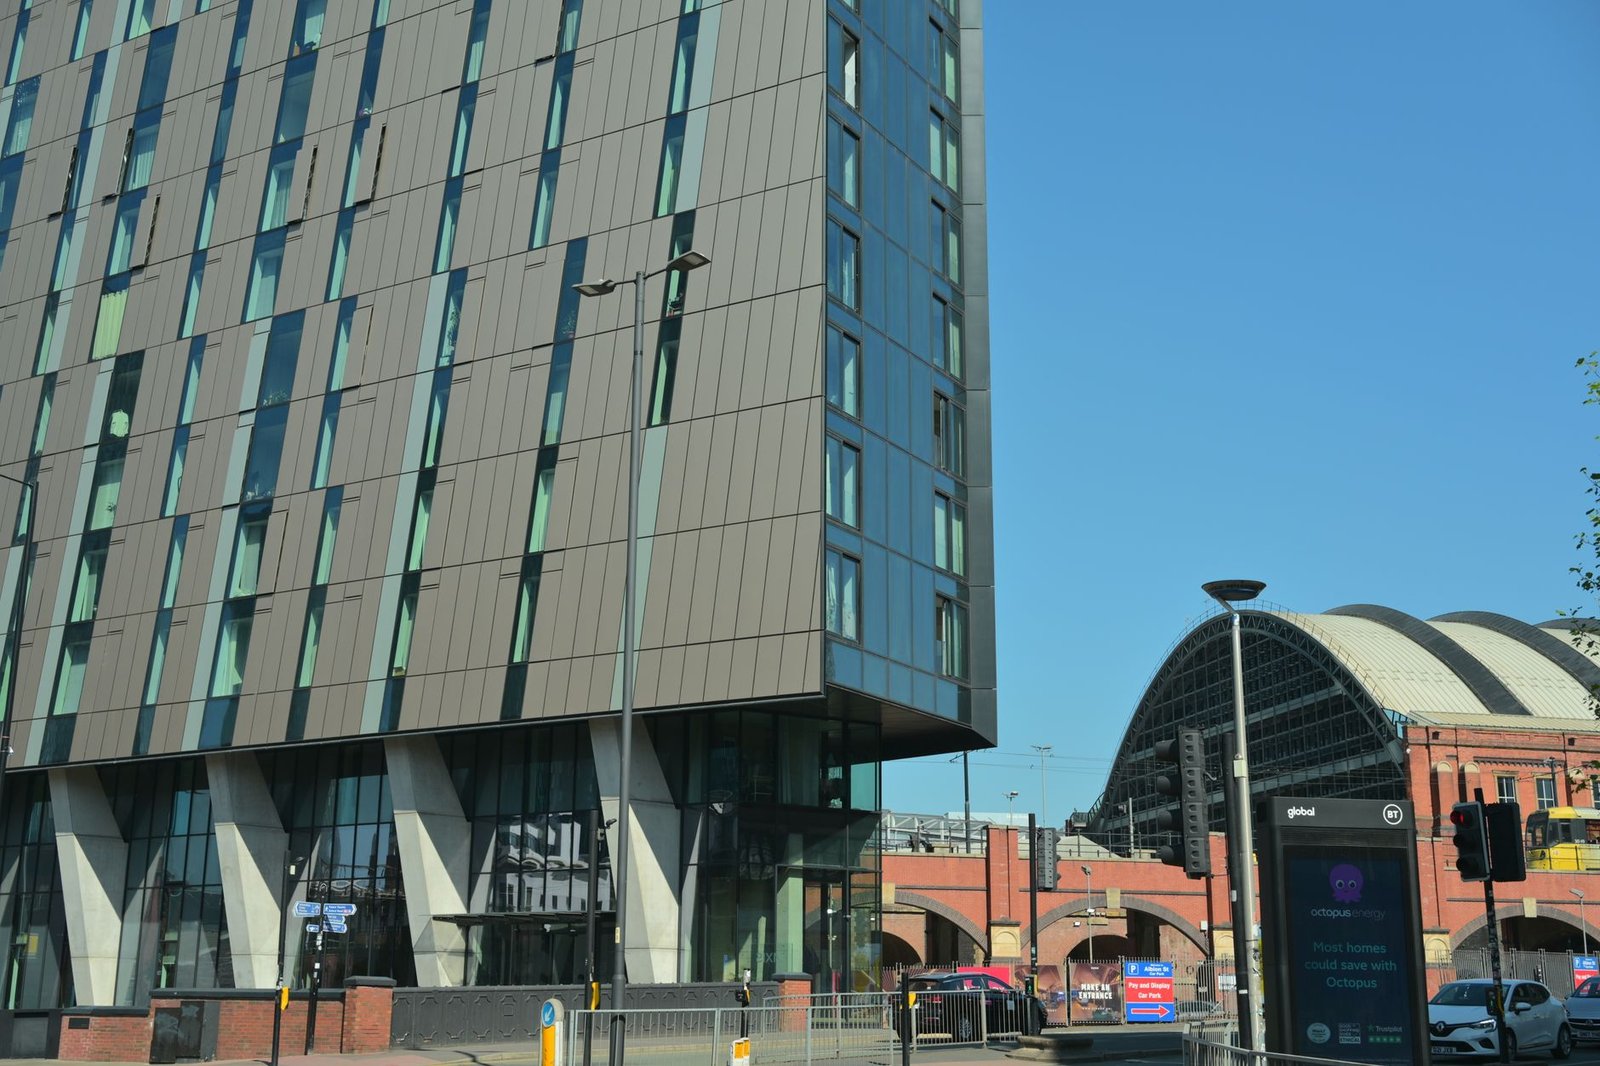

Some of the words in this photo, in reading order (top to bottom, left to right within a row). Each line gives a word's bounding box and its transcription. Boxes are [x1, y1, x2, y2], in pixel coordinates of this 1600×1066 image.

[1288, 806, 1315, 818] global
[1387, 810, 1398, 819] BT
[1310, 908, 1351, 919] octopus
[1352, 910, 1386, 920] energy
[1313, 942, 1343, 952] Most
[1347, 942, 1386, 953] homes
[1304, 960, 1337, 970] could
[1341, 962, 1367, 970] save
[1371, 960, 1397, 971] with
[1151, 982, 1170, 990] Display
[1326, 977, 1377, 989] Octopus
[1376, 1025, 1402, 1033] Trustpilot
